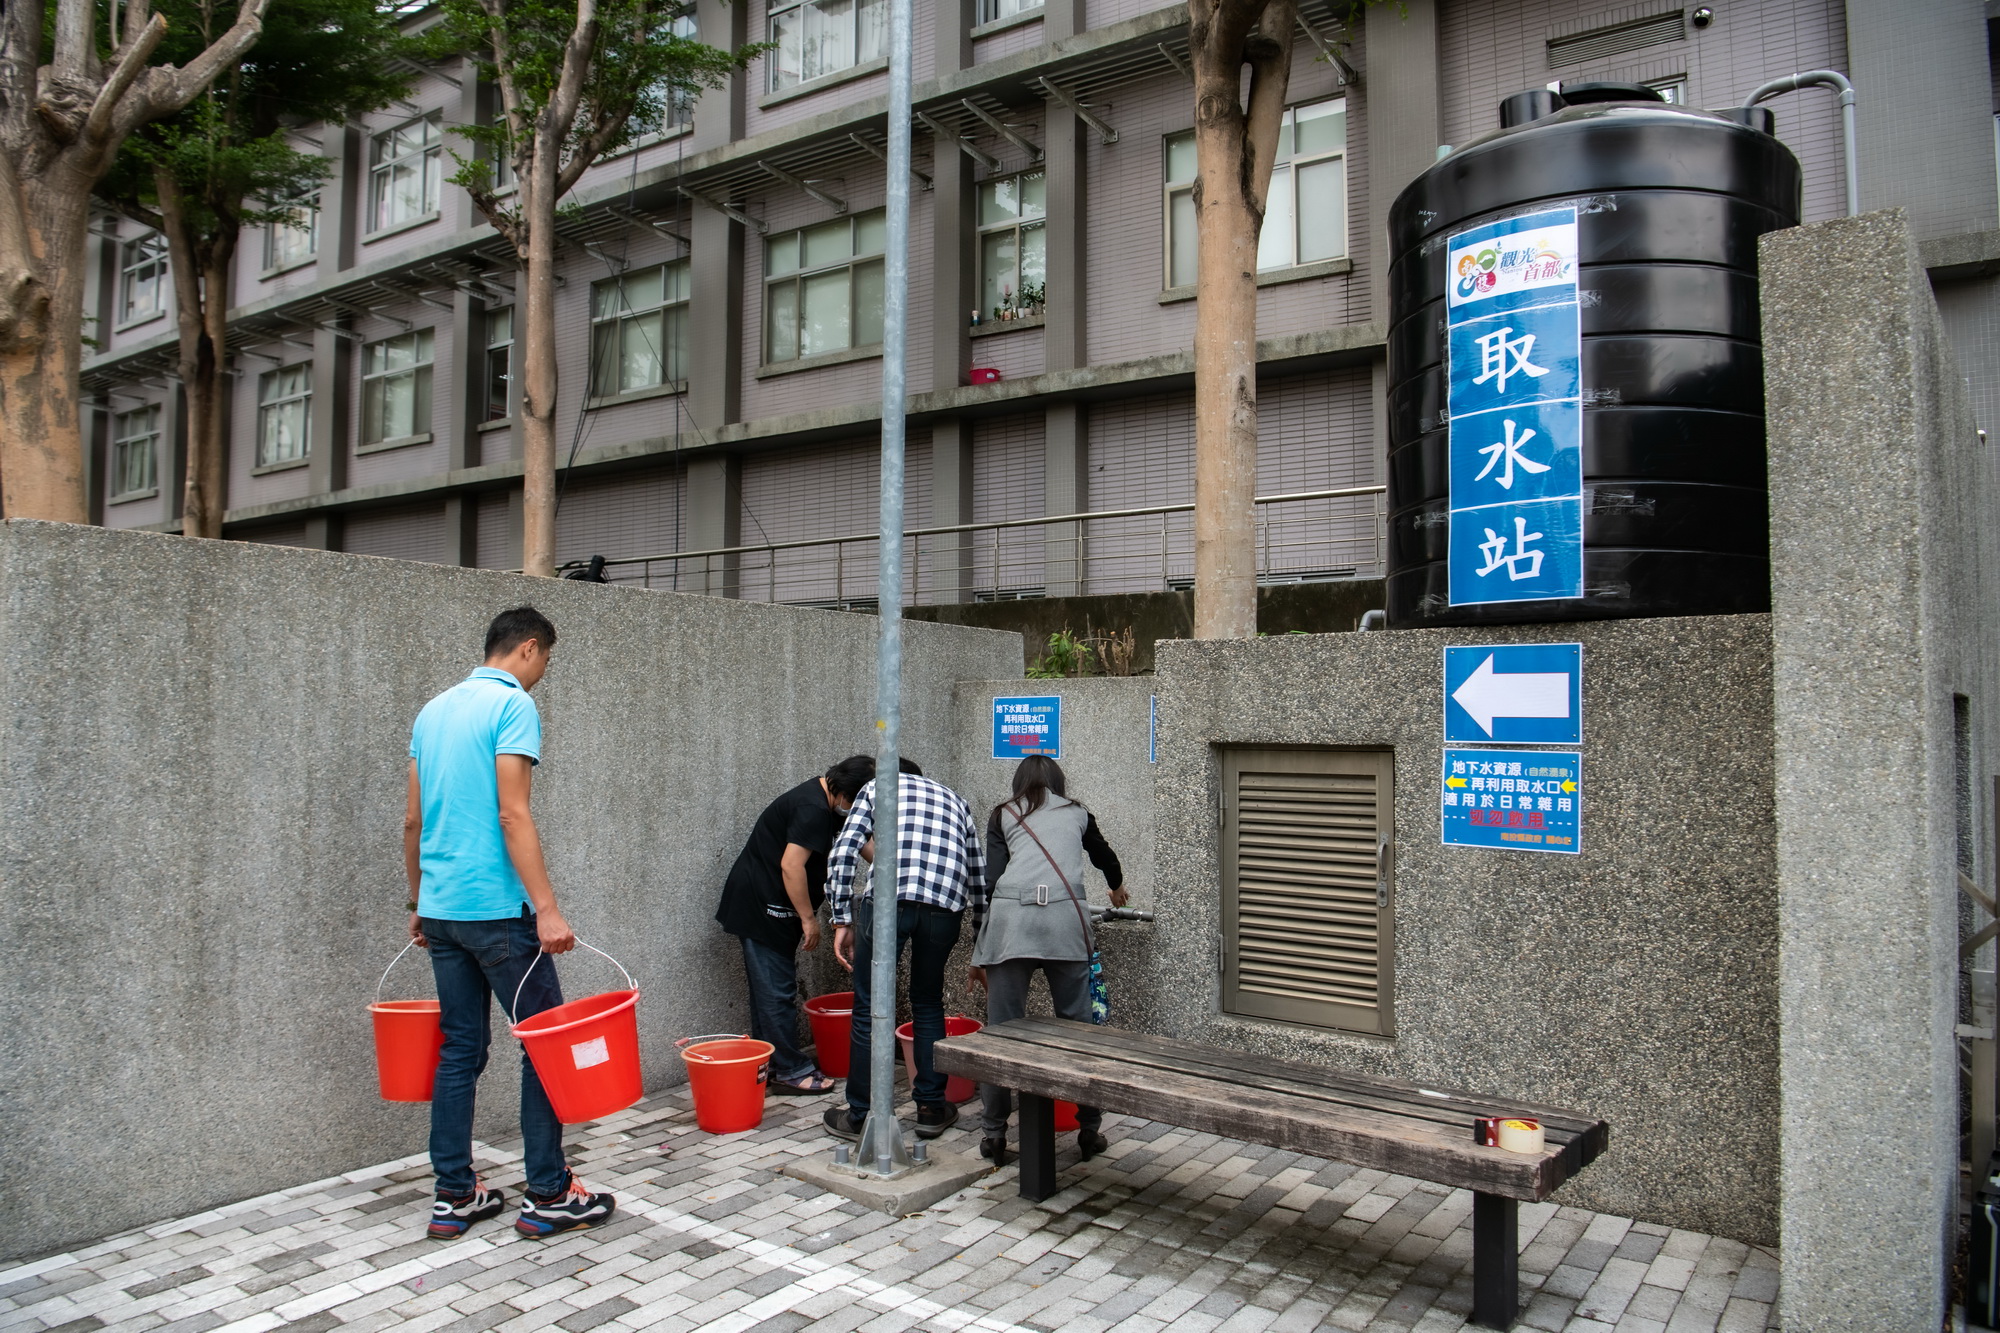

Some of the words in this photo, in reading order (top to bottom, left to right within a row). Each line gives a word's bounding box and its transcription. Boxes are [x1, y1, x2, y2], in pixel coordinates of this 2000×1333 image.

[1500, 247, 1536, 269] 觀光
[1523, 260, 1561, 283] 首都
[1472, 326, 1551, 582] 取水站
[1004, 714, 1045, 723] 再利用取水口
[1452, 760, 1522, 776] 地下水資源
[1471, 777, 1561, 794] 再利用取水口
[1444, 792, 1572, 812] 適用於日常雜用
